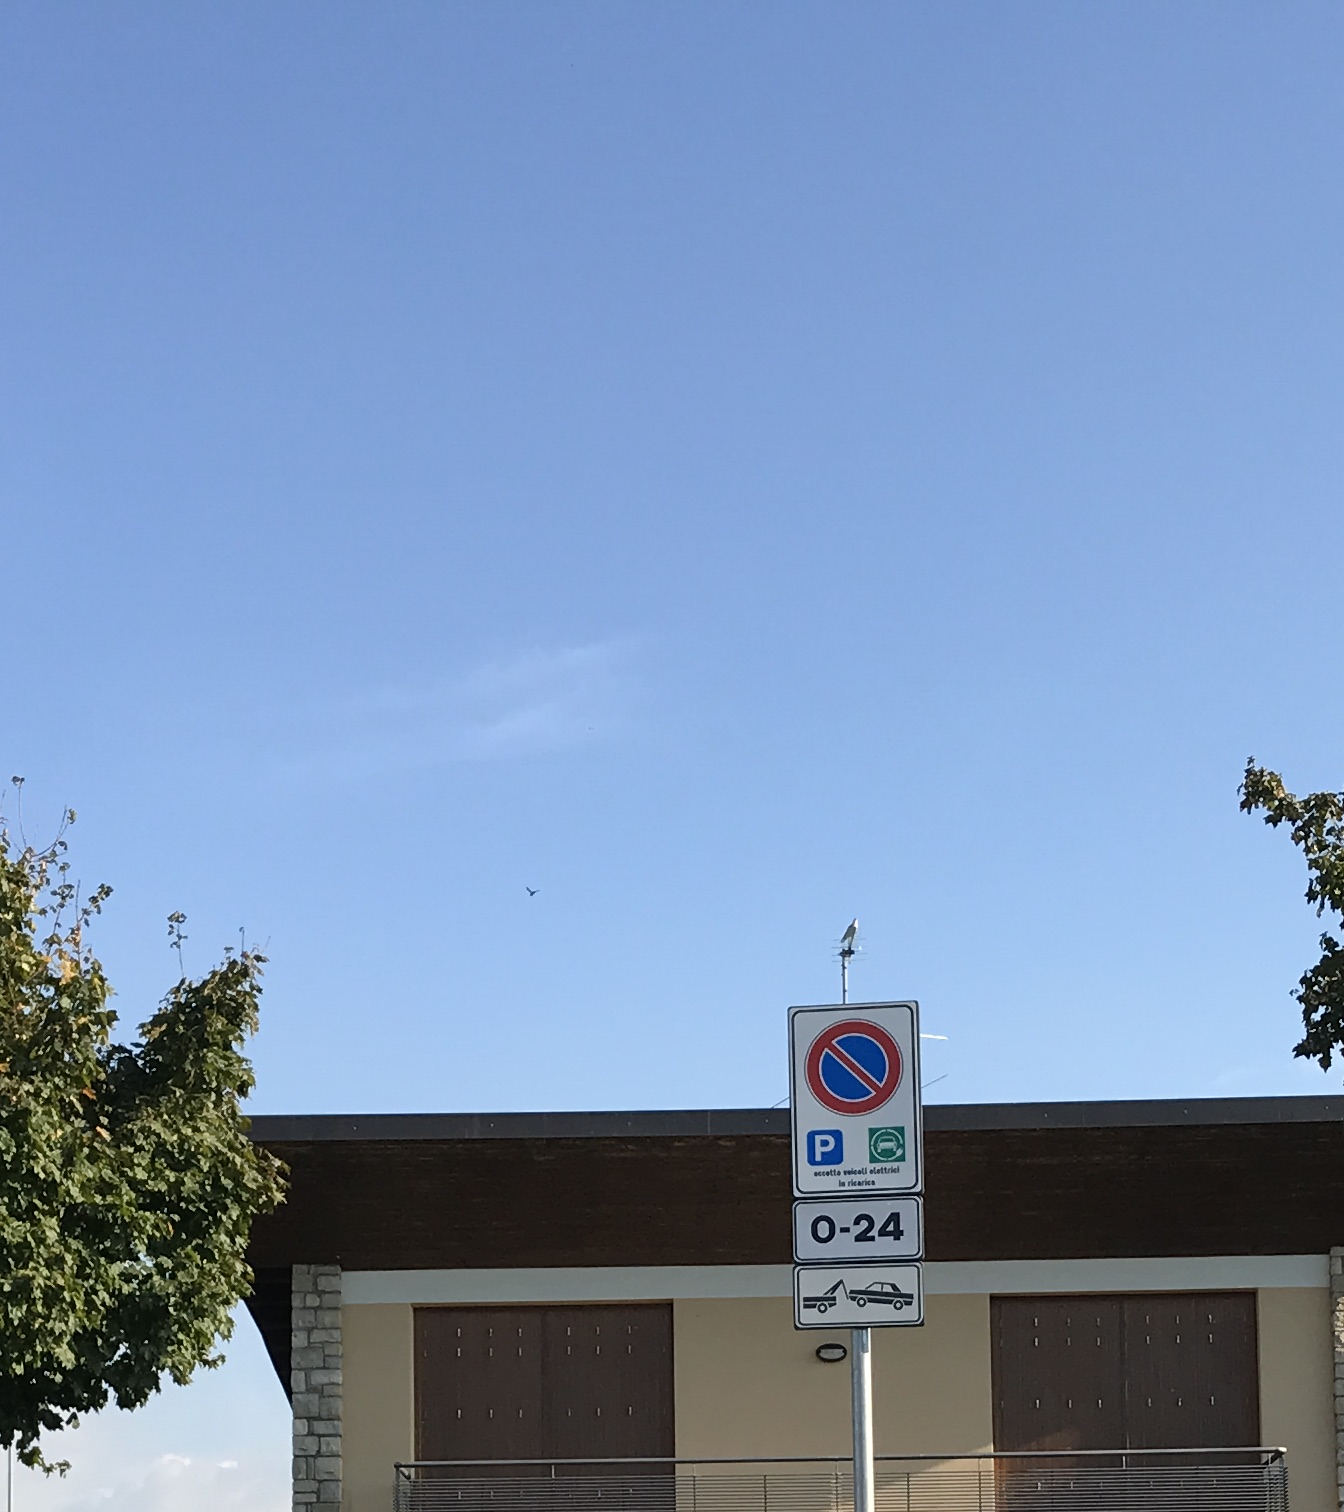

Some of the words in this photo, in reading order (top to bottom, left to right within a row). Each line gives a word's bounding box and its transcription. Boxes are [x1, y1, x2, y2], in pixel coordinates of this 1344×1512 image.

[814, 1134, 836, 1162] P
[843, 1167, 868, 1176] veicoli
[847, 1178, 876, 1187] ricarica
[810, 1211, 904, 1244] 0-24
